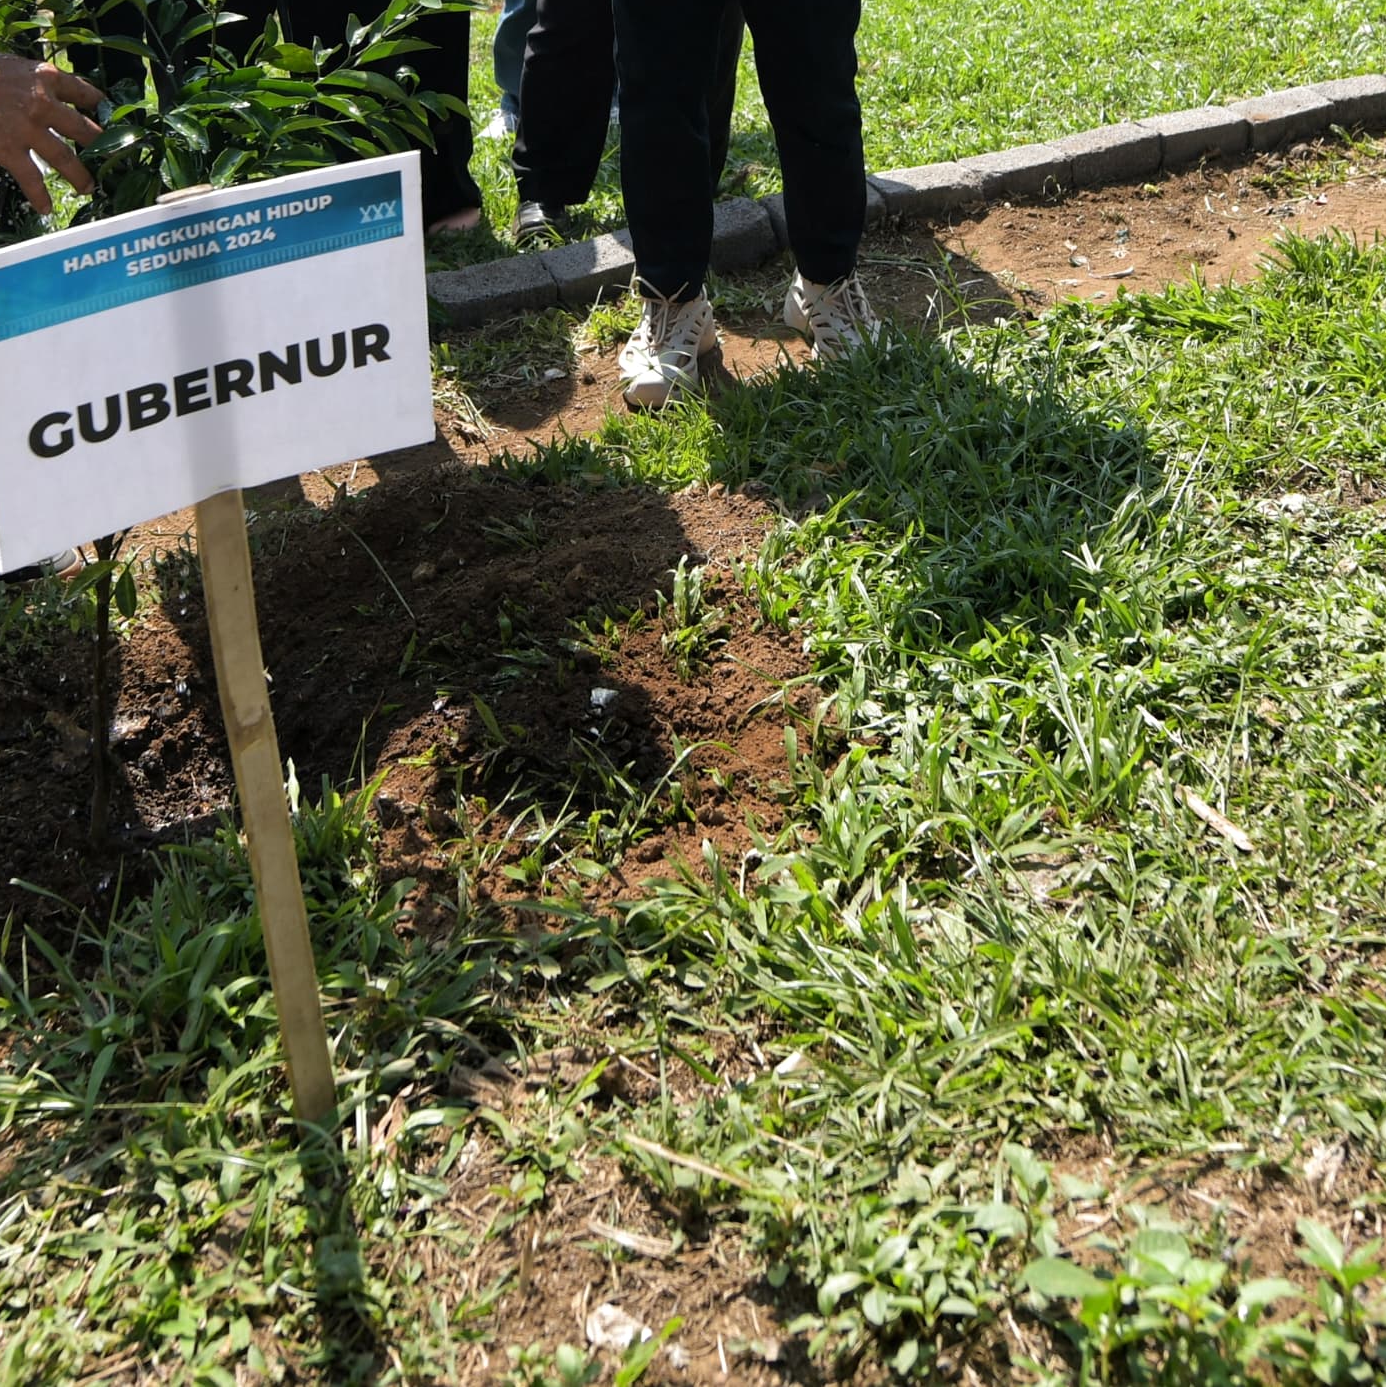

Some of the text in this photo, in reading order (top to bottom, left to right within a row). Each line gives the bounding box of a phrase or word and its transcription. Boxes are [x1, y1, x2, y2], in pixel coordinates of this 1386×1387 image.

[63, 194, 333, 274] HARI LINGKUNGAN HIDUP
[126, 227, 277, 277] SEDUNIA 2024
[28, 323, 392, 459] GUBERNUR
